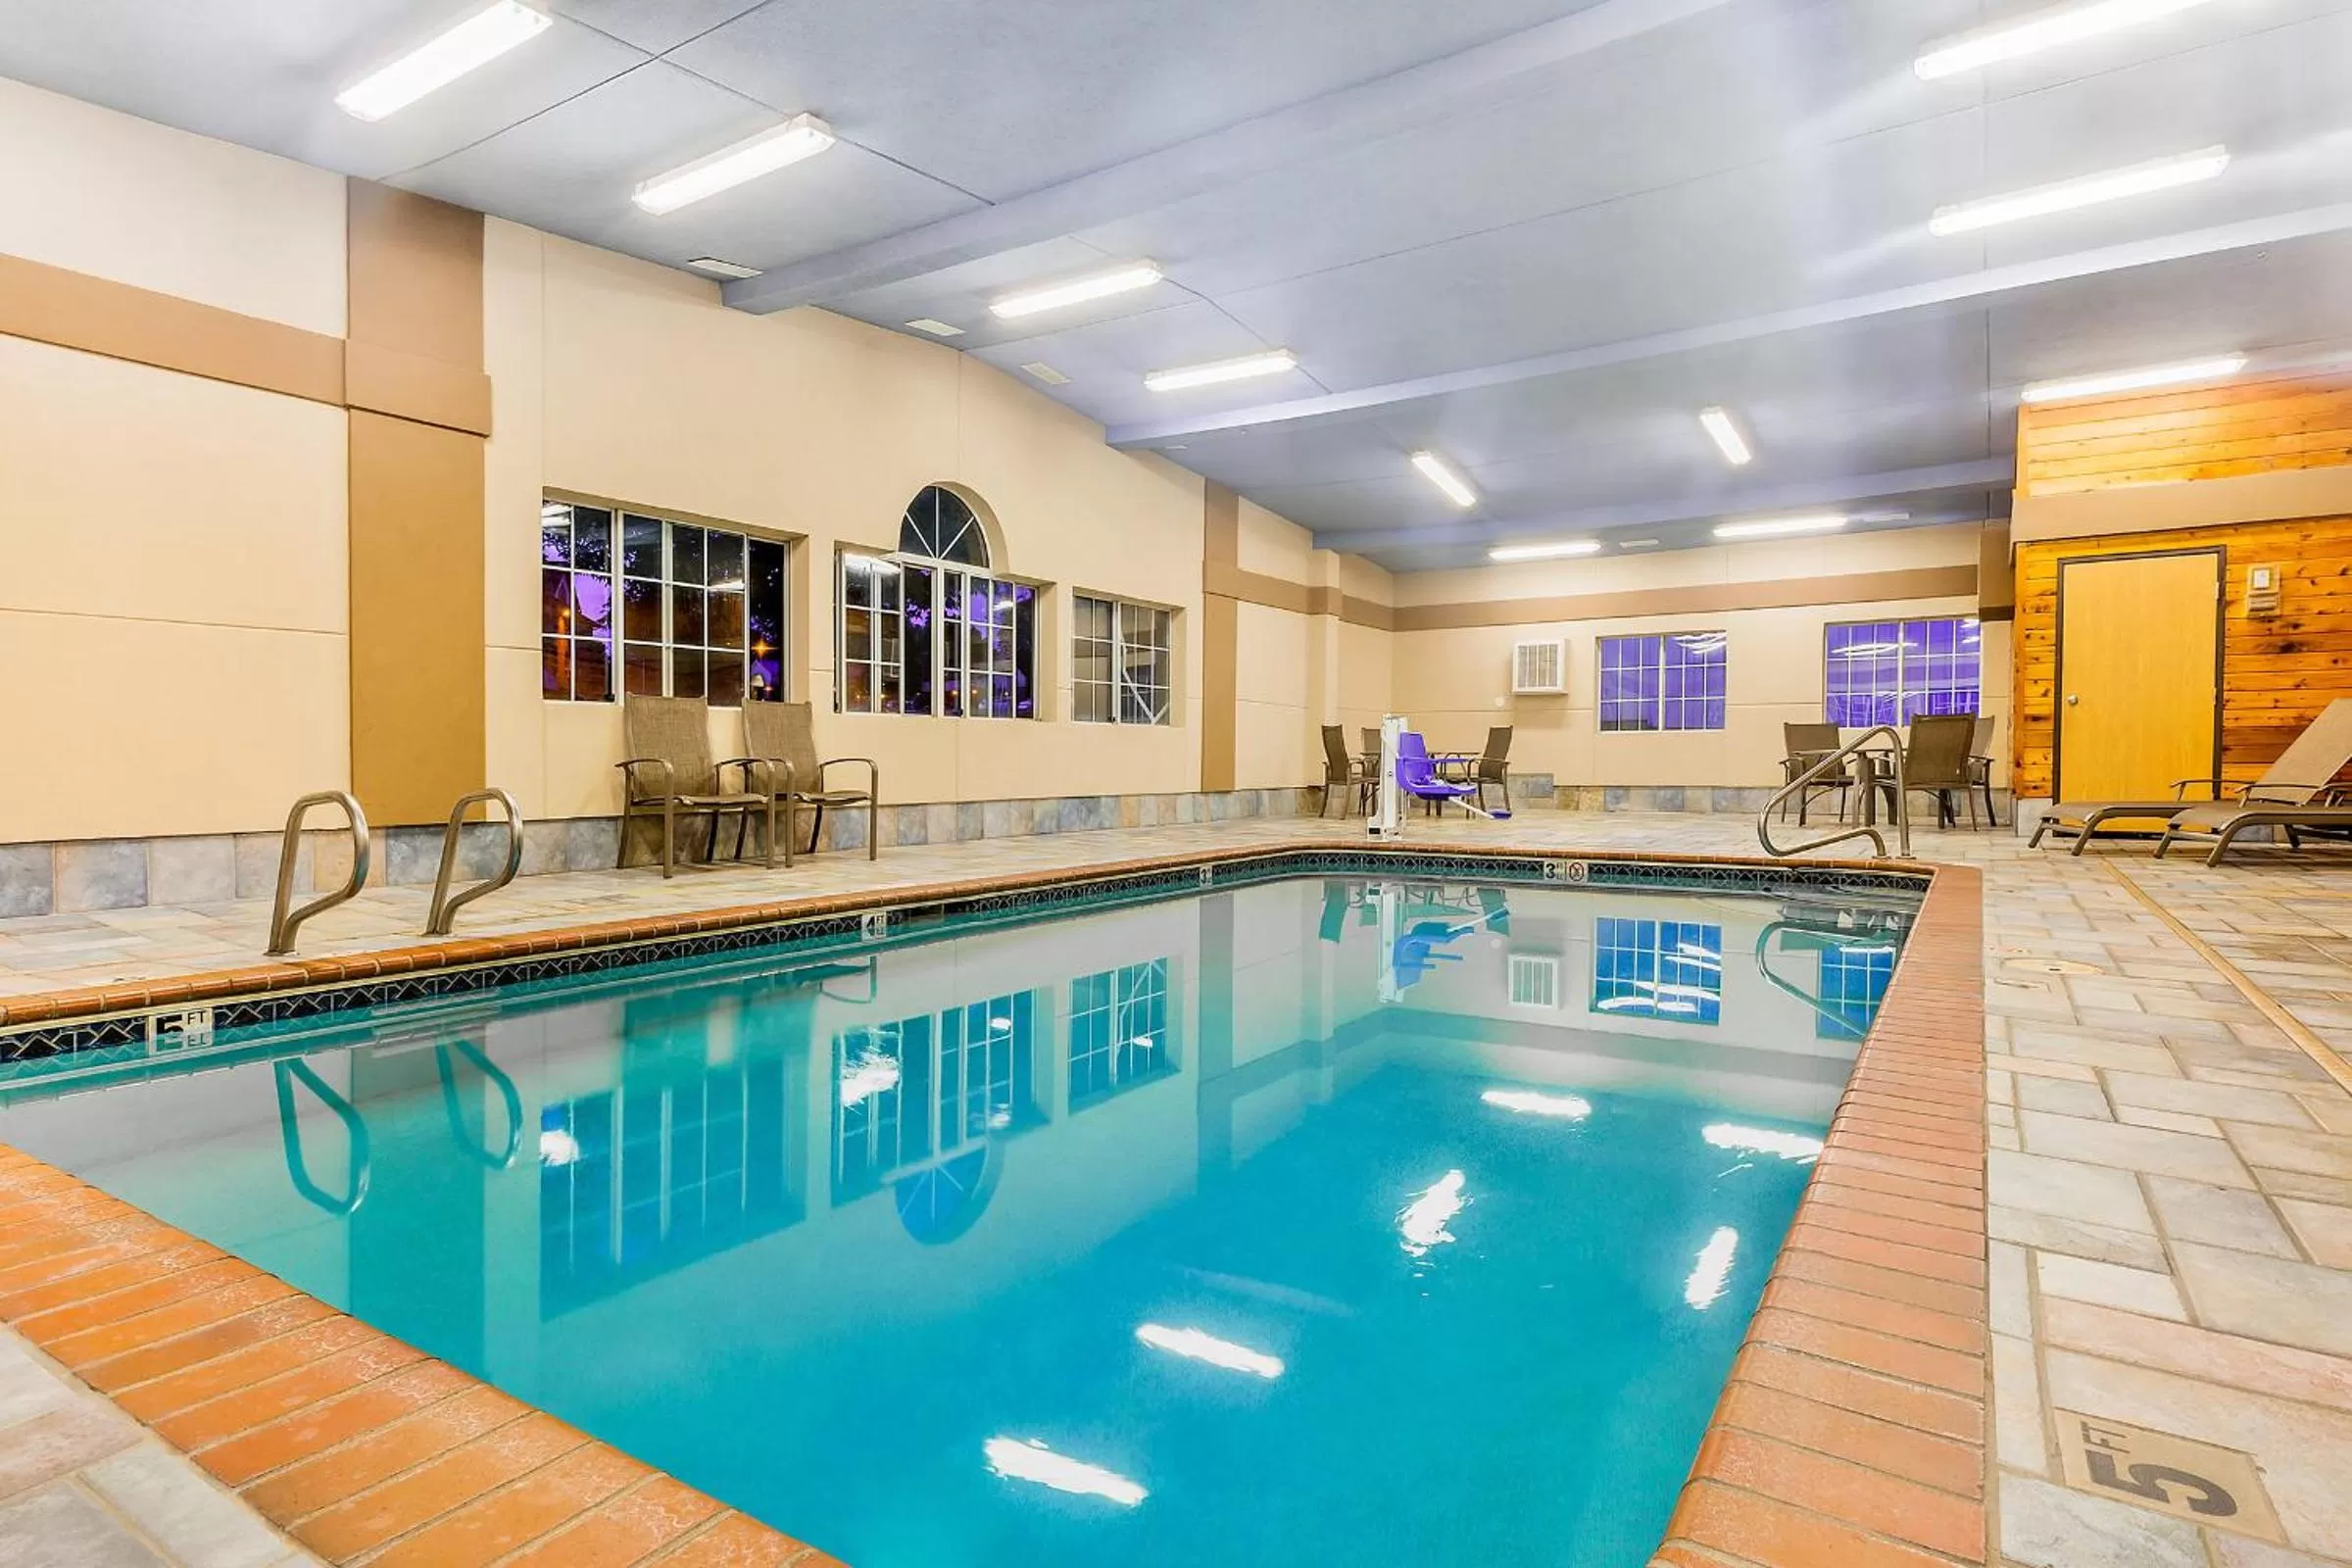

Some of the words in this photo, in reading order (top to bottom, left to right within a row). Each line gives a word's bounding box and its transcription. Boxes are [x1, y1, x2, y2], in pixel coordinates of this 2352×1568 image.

[1545, 862, 1556, 879] 3
[187, 1010, 207, 1025] FT
[2080, 1420, 2131, 1454] FT
[2084, 1448, 2237, 1517] 5
